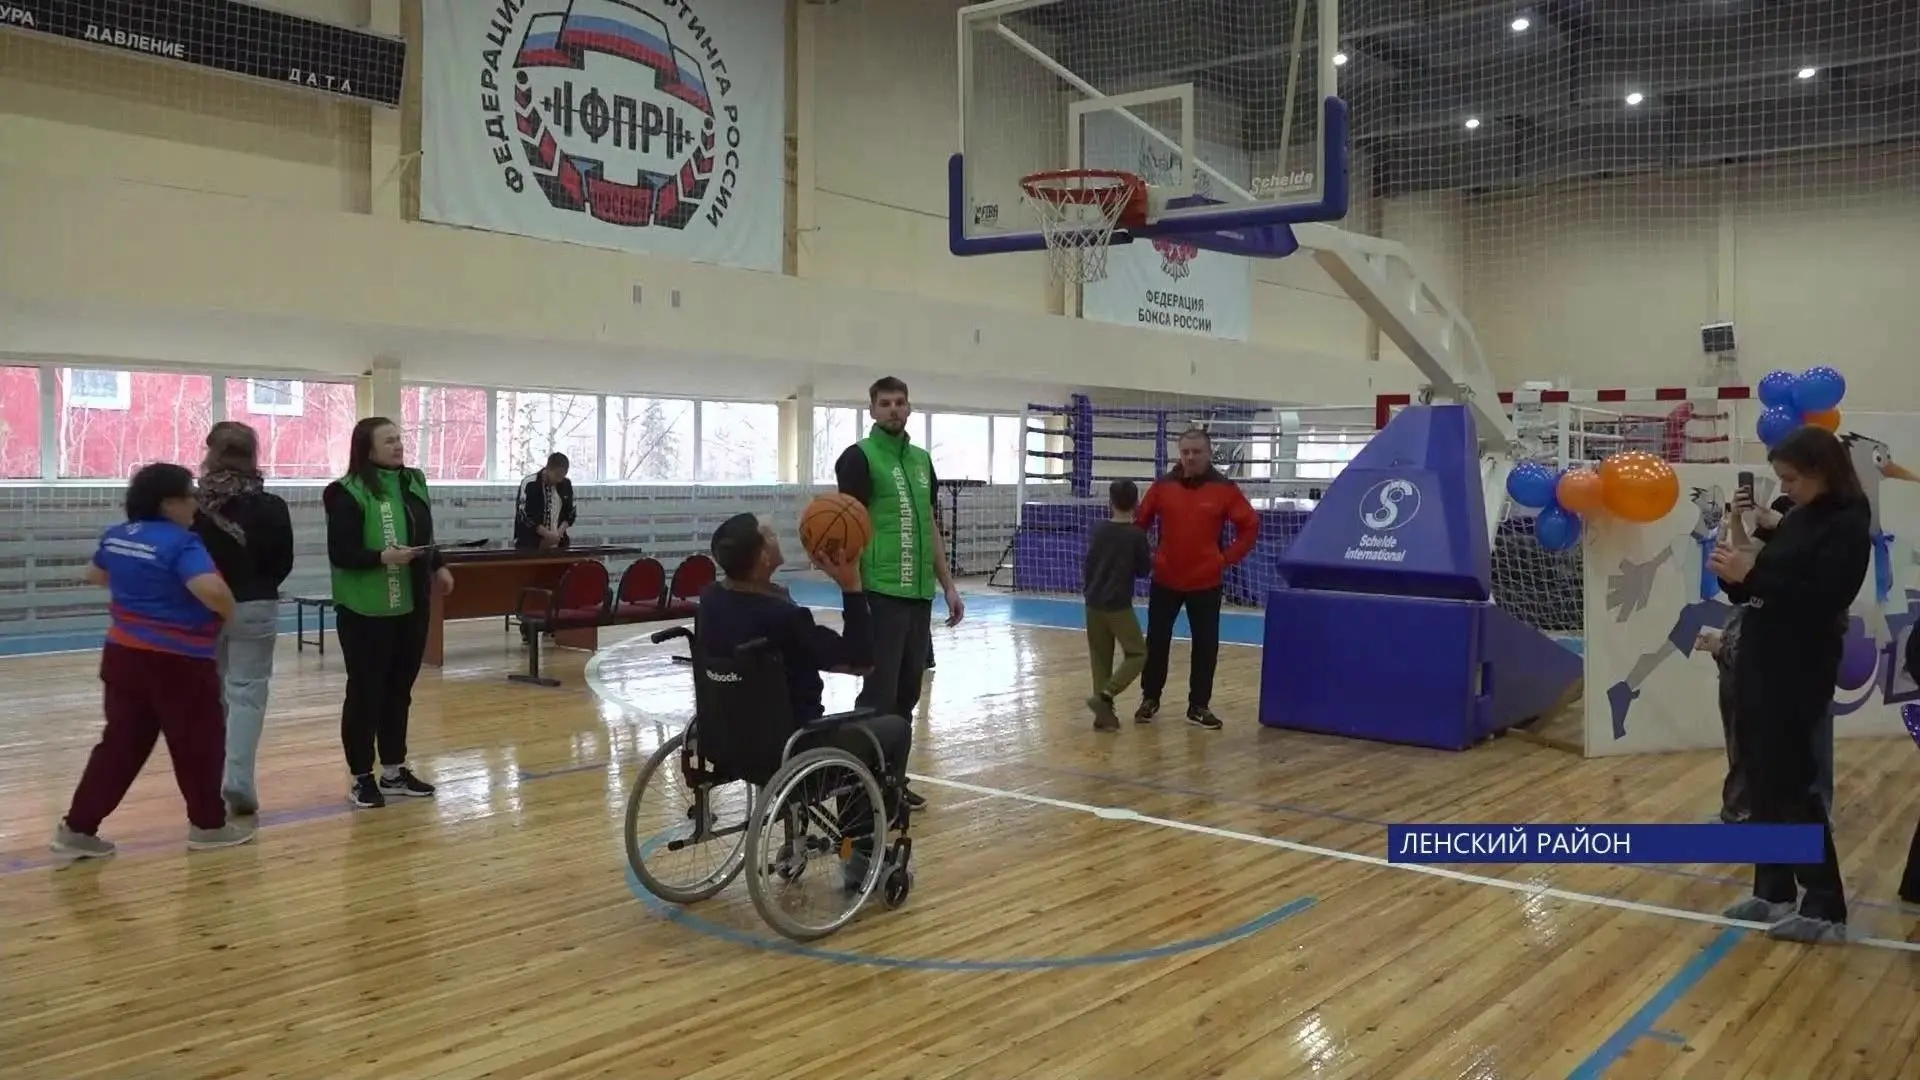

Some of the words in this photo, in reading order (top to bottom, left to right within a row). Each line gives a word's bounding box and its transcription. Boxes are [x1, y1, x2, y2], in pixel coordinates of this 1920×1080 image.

[84, 24, 185, 57] ДАВЛЕНИЕ
[289, 67, 352, 92] ДАТА
[481, 0, 525, 193] ФЕДЕРАЦИ
[663, 0, 731, 96] ТИНГА
[706, 105, 740, 228] РОССИИ
[1146, 290, 1204, 312] ФЕДЕРАЦИЯ
[1138, 308, 1171, 326] БОКСА
[1174, 313, 1211, 332] РОССИИ
[1360, 534, 1397, 548] Schelde
